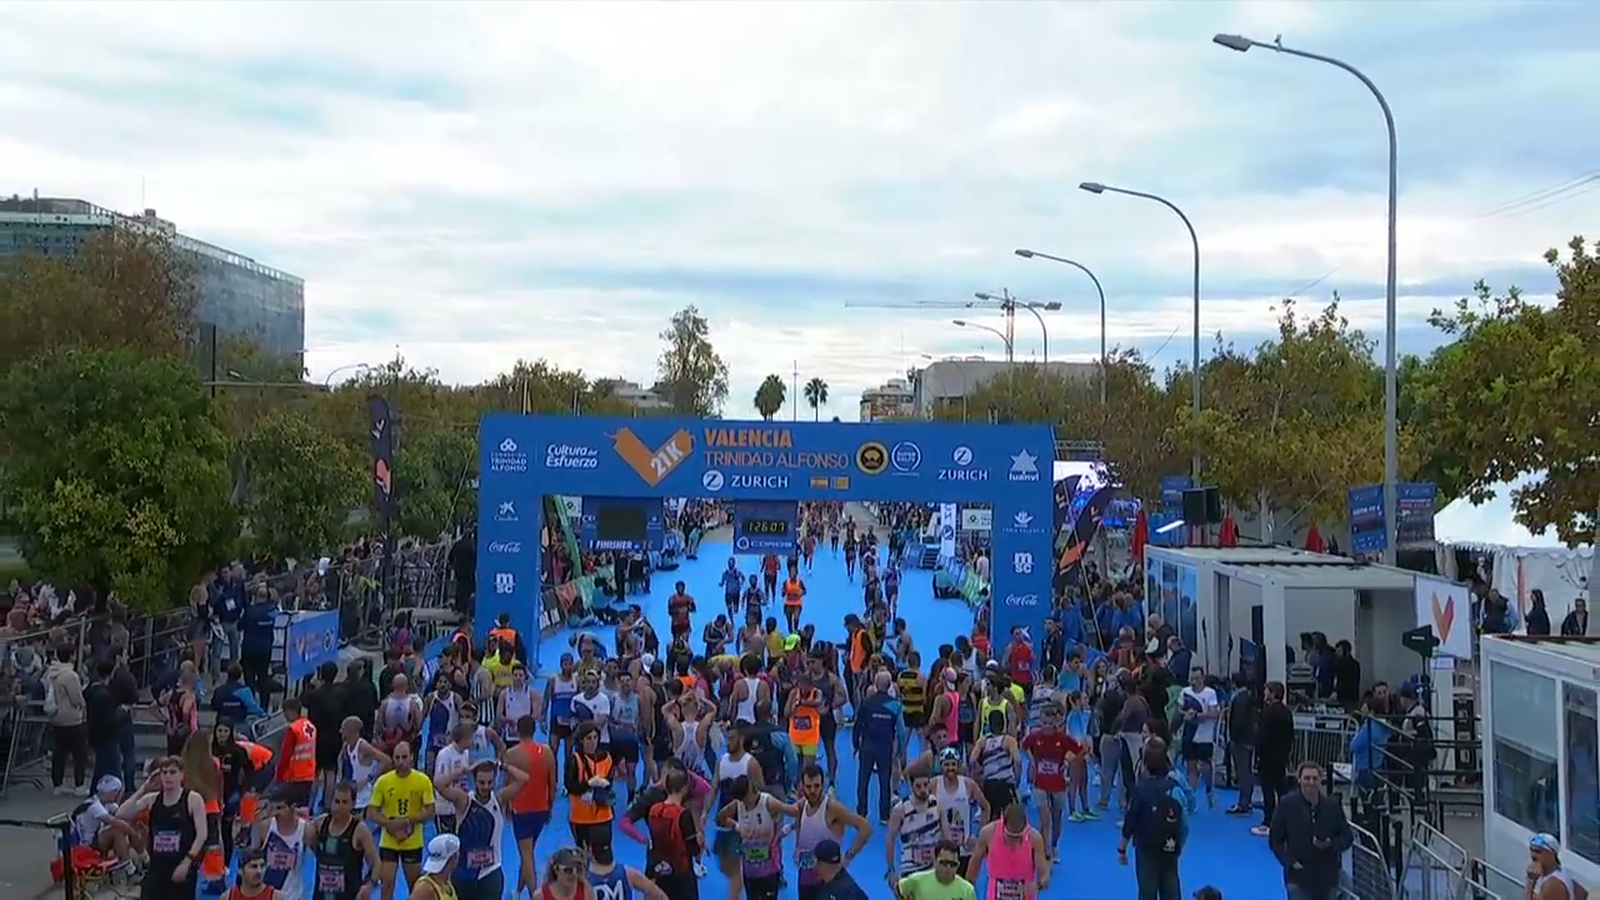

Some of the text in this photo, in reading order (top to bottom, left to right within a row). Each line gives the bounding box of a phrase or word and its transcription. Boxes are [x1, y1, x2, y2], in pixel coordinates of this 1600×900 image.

[704, 427, 793, 448] VALENCIA
[547, 443, 588, 456] Cultura
[545, 455, 599, 468] Esfuerzo
[650, 439, 685, 479] 21K
[704, 451, 850, 469] TRINIDAD ALFONSO
[730, 474, 789, 489] ZURICH
[938, 469, 989, 481] ZURICH
